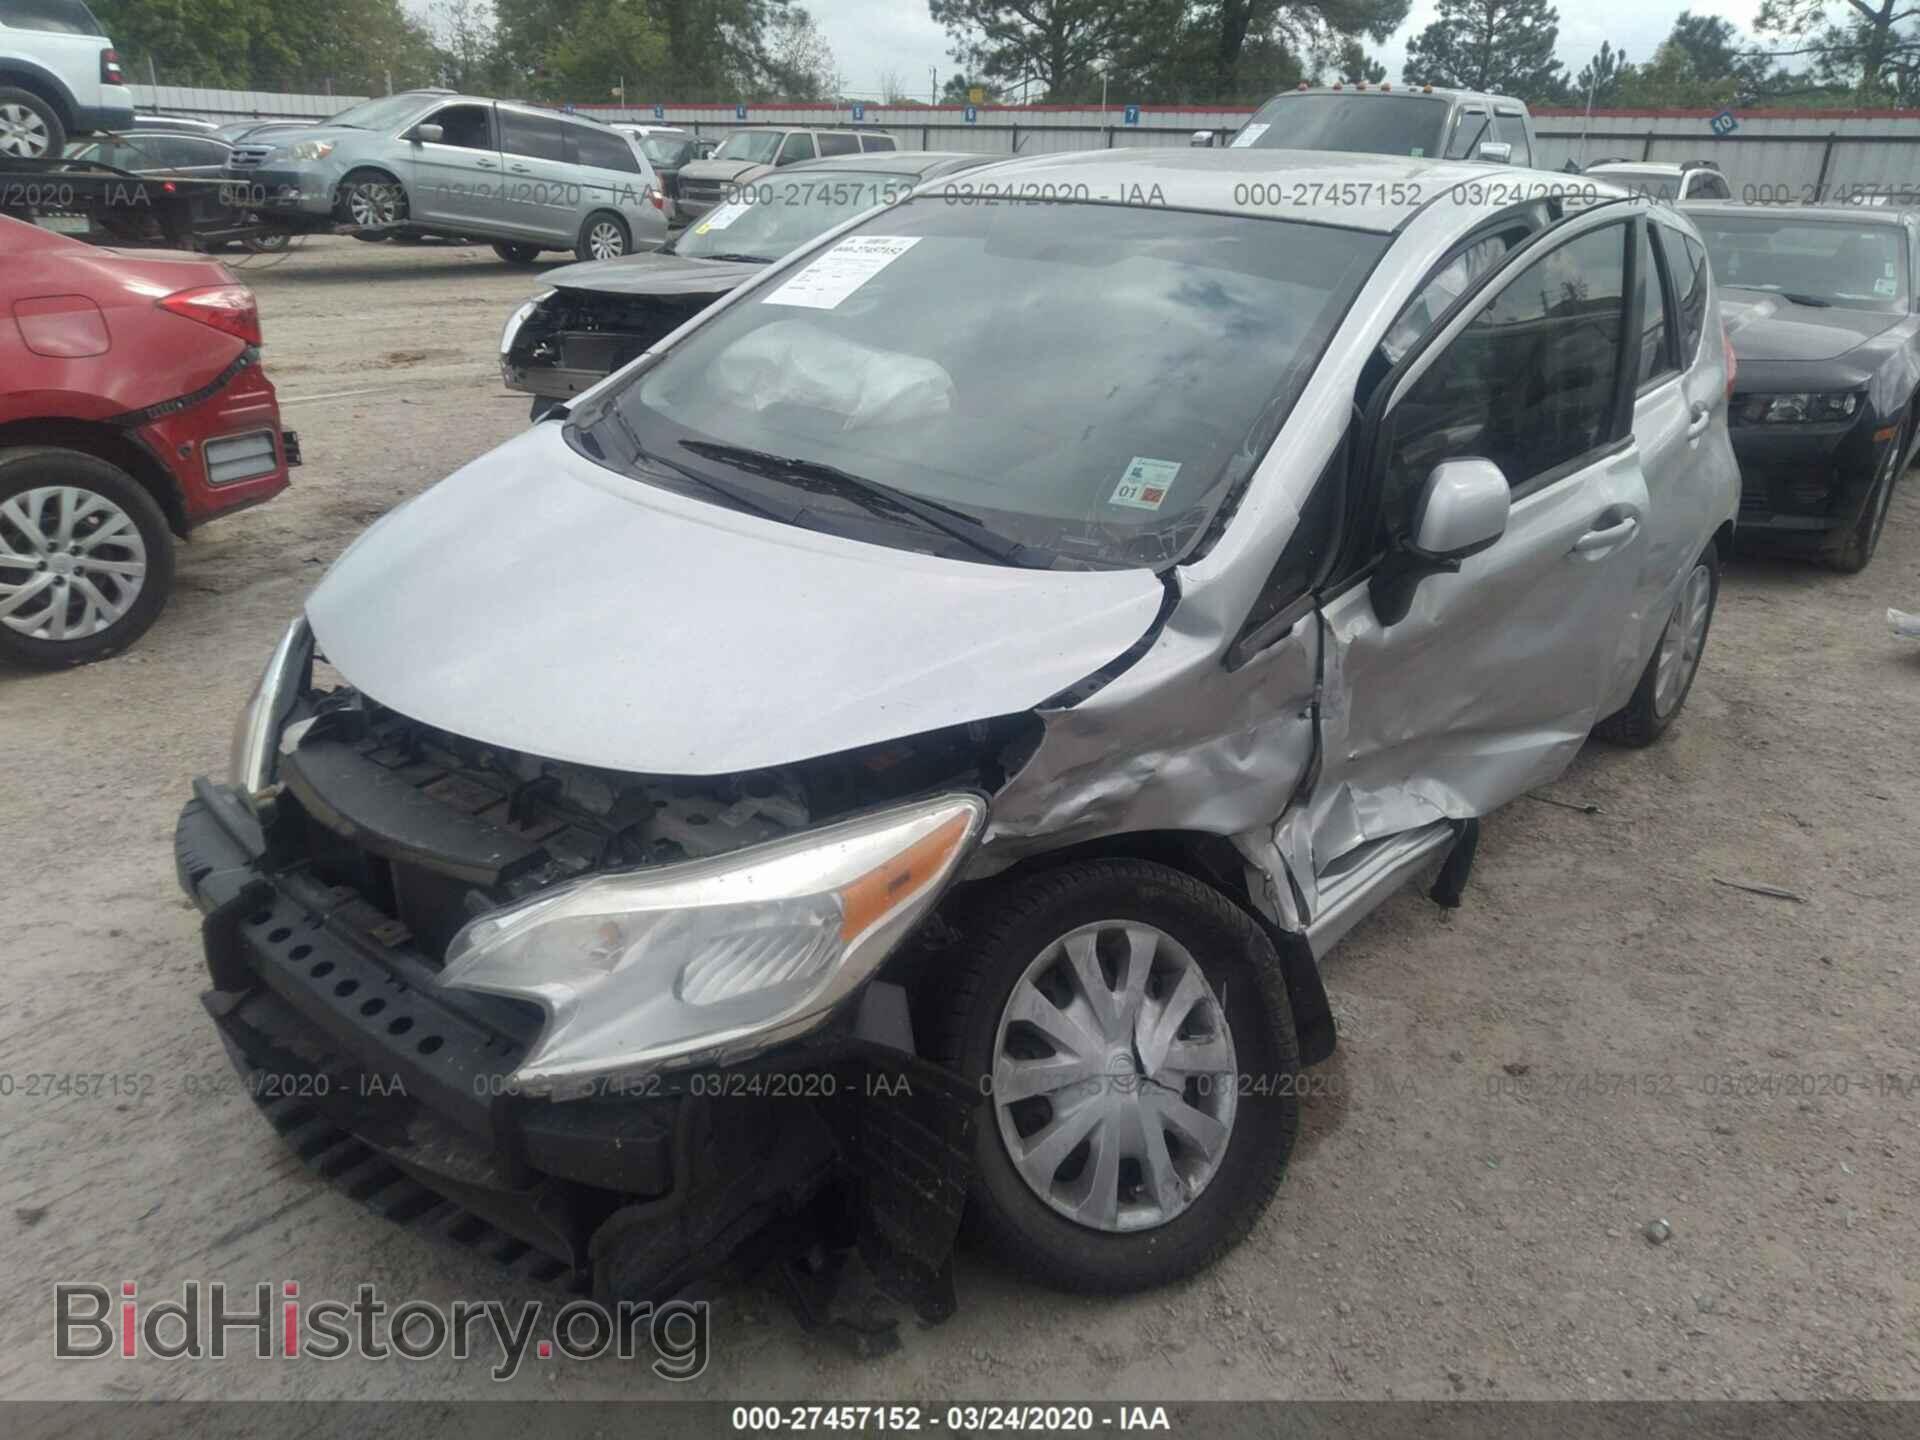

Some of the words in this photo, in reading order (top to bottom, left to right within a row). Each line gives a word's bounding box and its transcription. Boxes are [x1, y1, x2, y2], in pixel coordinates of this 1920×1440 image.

[1128, 108, 1137, 121] 7
[1714, 115, 1733, 132] 10
[1118, 486, 1138, 498] 01
